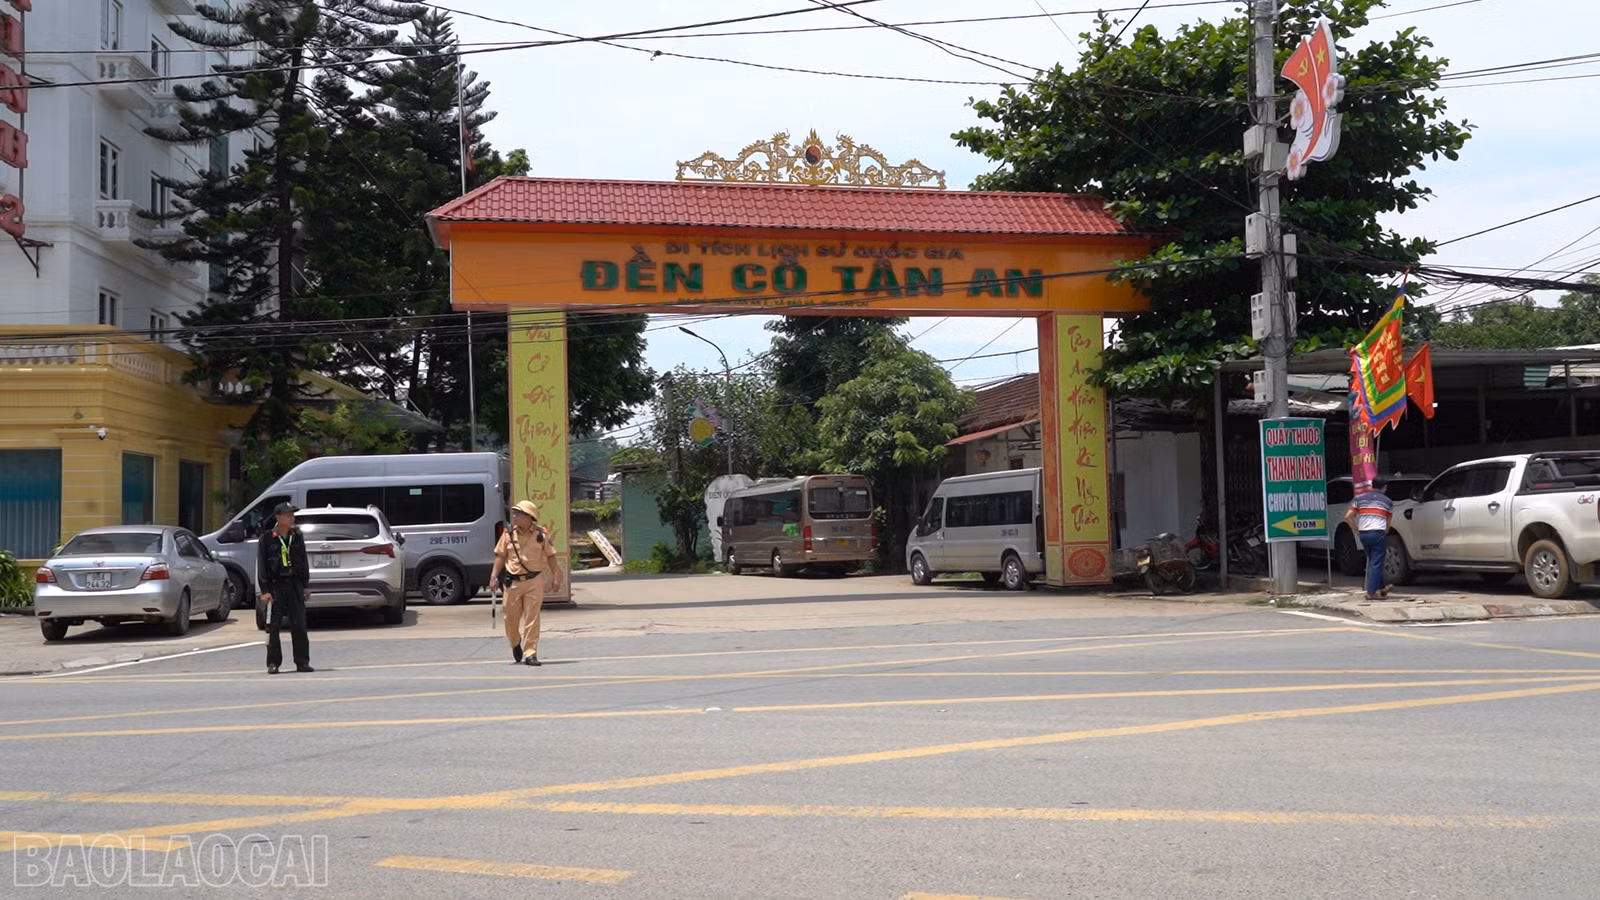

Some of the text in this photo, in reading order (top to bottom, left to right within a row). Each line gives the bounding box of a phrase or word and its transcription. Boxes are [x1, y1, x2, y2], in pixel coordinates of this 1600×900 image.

[666, 242, 689, 254] DI
[698, 240, 751, 256] TÍCH
[757, 243, 809, 260] LỊCH
[852, 240, 917, 259] QUỐC
[923, 247, 965, 261] GIA
[580, 244, 1044, 298] ĐỀN CÔ TÂN AN
[1290, 420, 1321, 446] THUỐC
[1266, 455, 1297, 482] THANH
[1297, 449, 1323, 481] NGÂN
[1291, 520, 1317, 529] 100M
